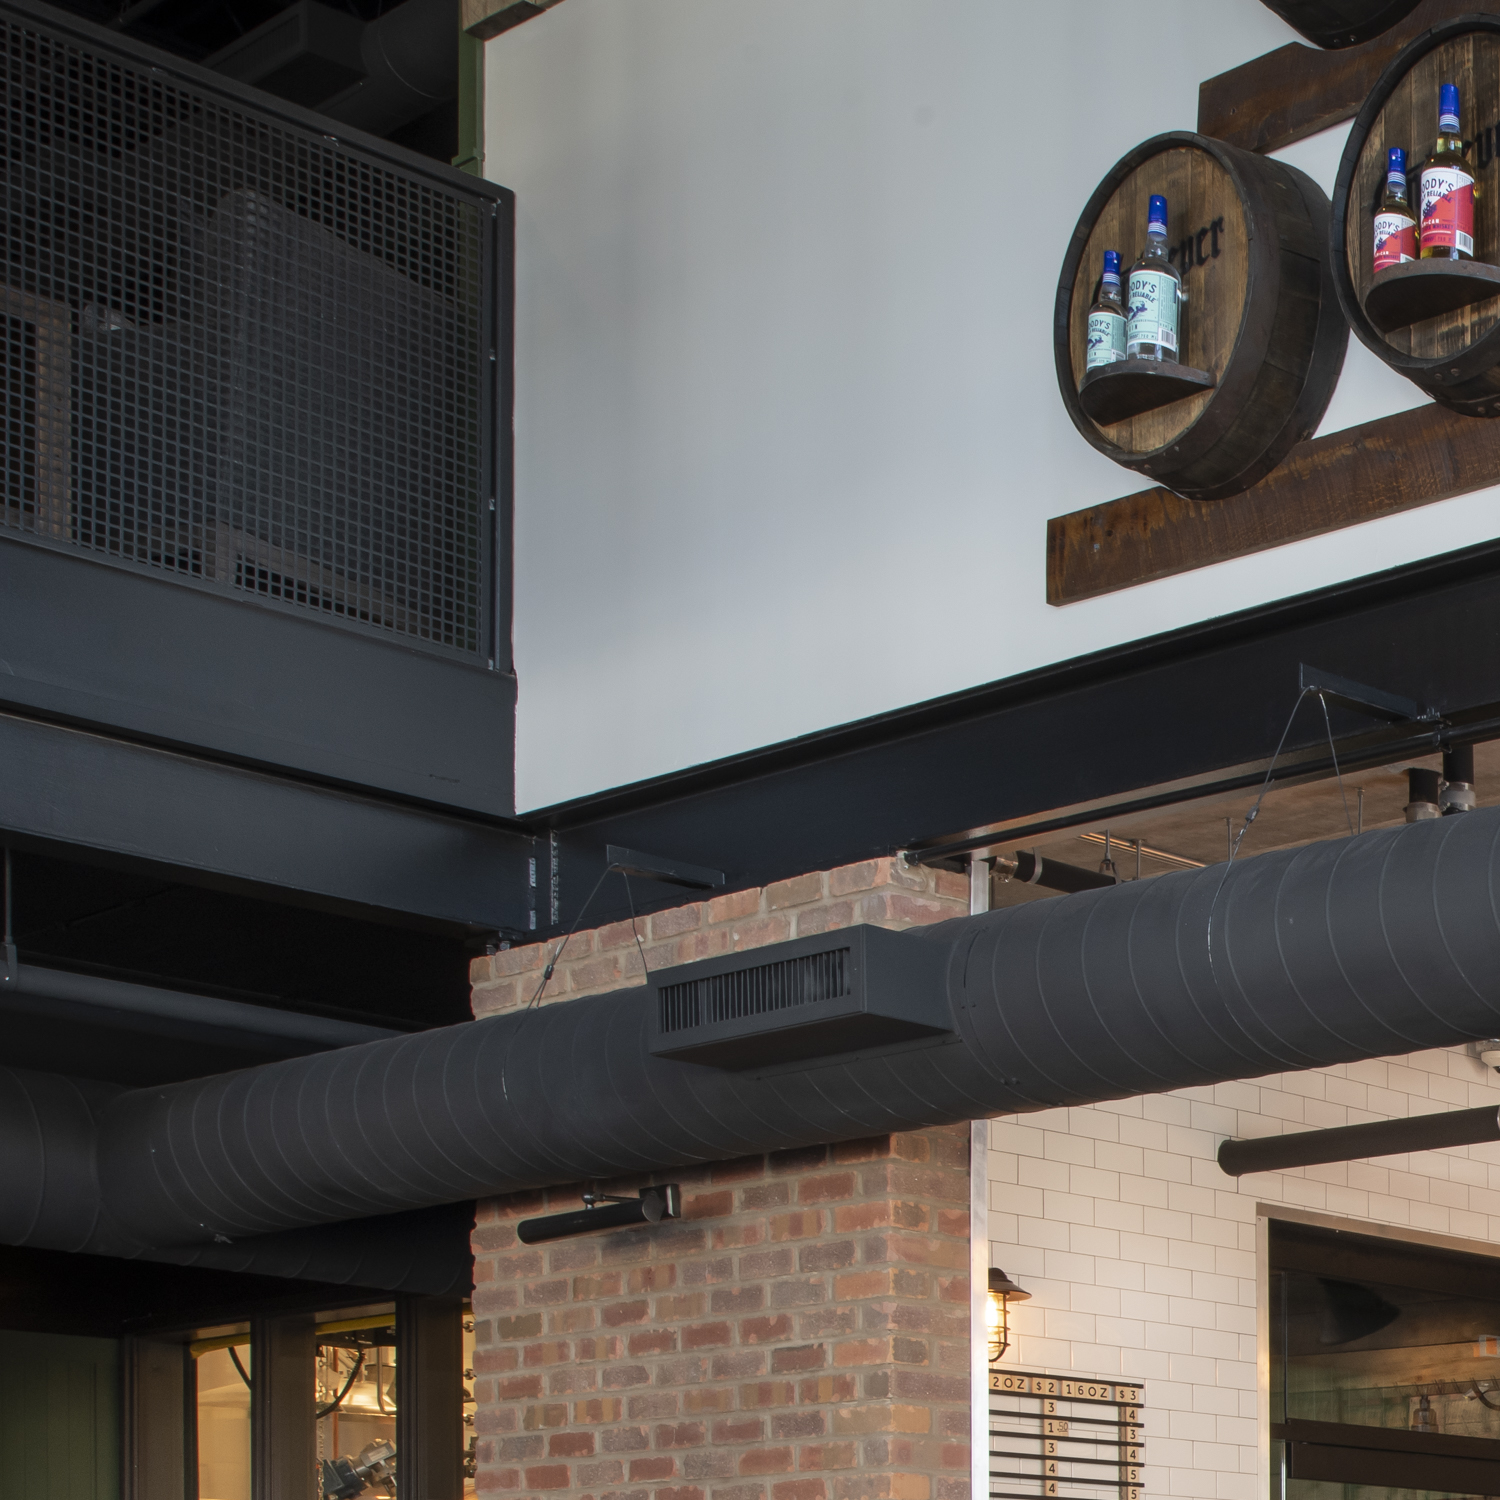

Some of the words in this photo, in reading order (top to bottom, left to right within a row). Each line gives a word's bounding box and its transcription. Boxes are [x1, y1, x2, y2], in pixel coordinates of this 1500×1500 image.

[1421, 178, 1455, 193] OODY'S
[1374, 221, 1400, 233] OODY'S
[1036, 1381, 1055, 1393] $2
[1066, 1384, 1108, 1398] 16OZ
[1119, 1390, 1136, 1401] $3
[1048, 1402, 1054, 1413] 3
[1129, 1410, 1135, 1420] 4
[1048, 1422, 1053, 1433] 1
[1130, 1429, 1136, 1439] 3
[1048, 1442, 1055, 1453] 3
[1129, 1449, 1136, 1460] 4
[1049, 1463, 1055, 1473] 4
[1130, 1469, 1136, 1480] 5
[1049, 1483, 1055, 1493] 4
[1131, 1489, 1137, 1499] 5
